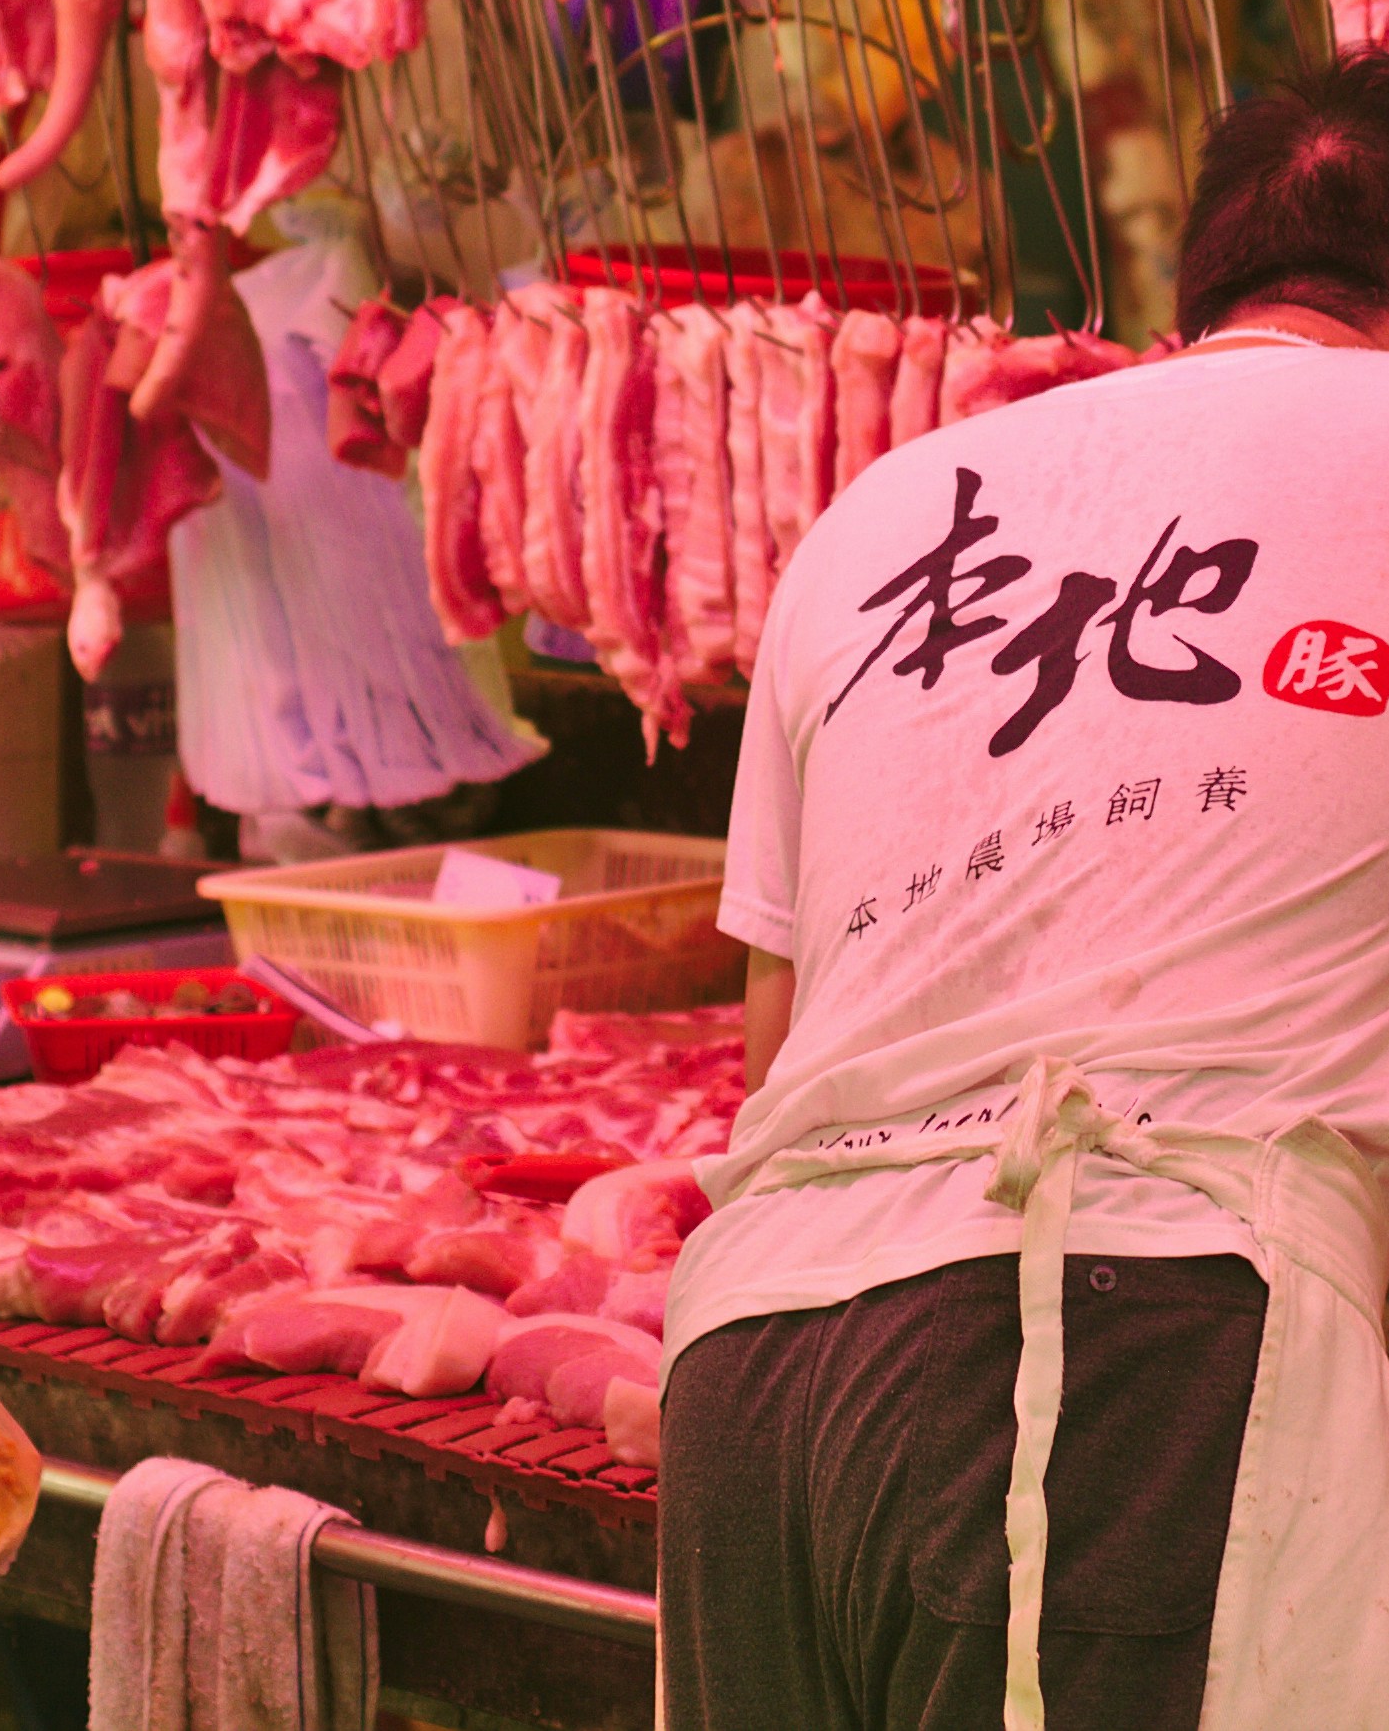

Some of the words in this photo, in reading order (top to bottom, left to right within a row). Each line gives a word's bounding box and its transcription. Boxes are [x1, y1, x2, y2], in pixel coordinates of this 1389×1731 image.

[823, 467, 1259, 758] 本地
[1274, 627, 1386, 706] 豚
[846, 765, 1248, 940] 本地農場飼養
